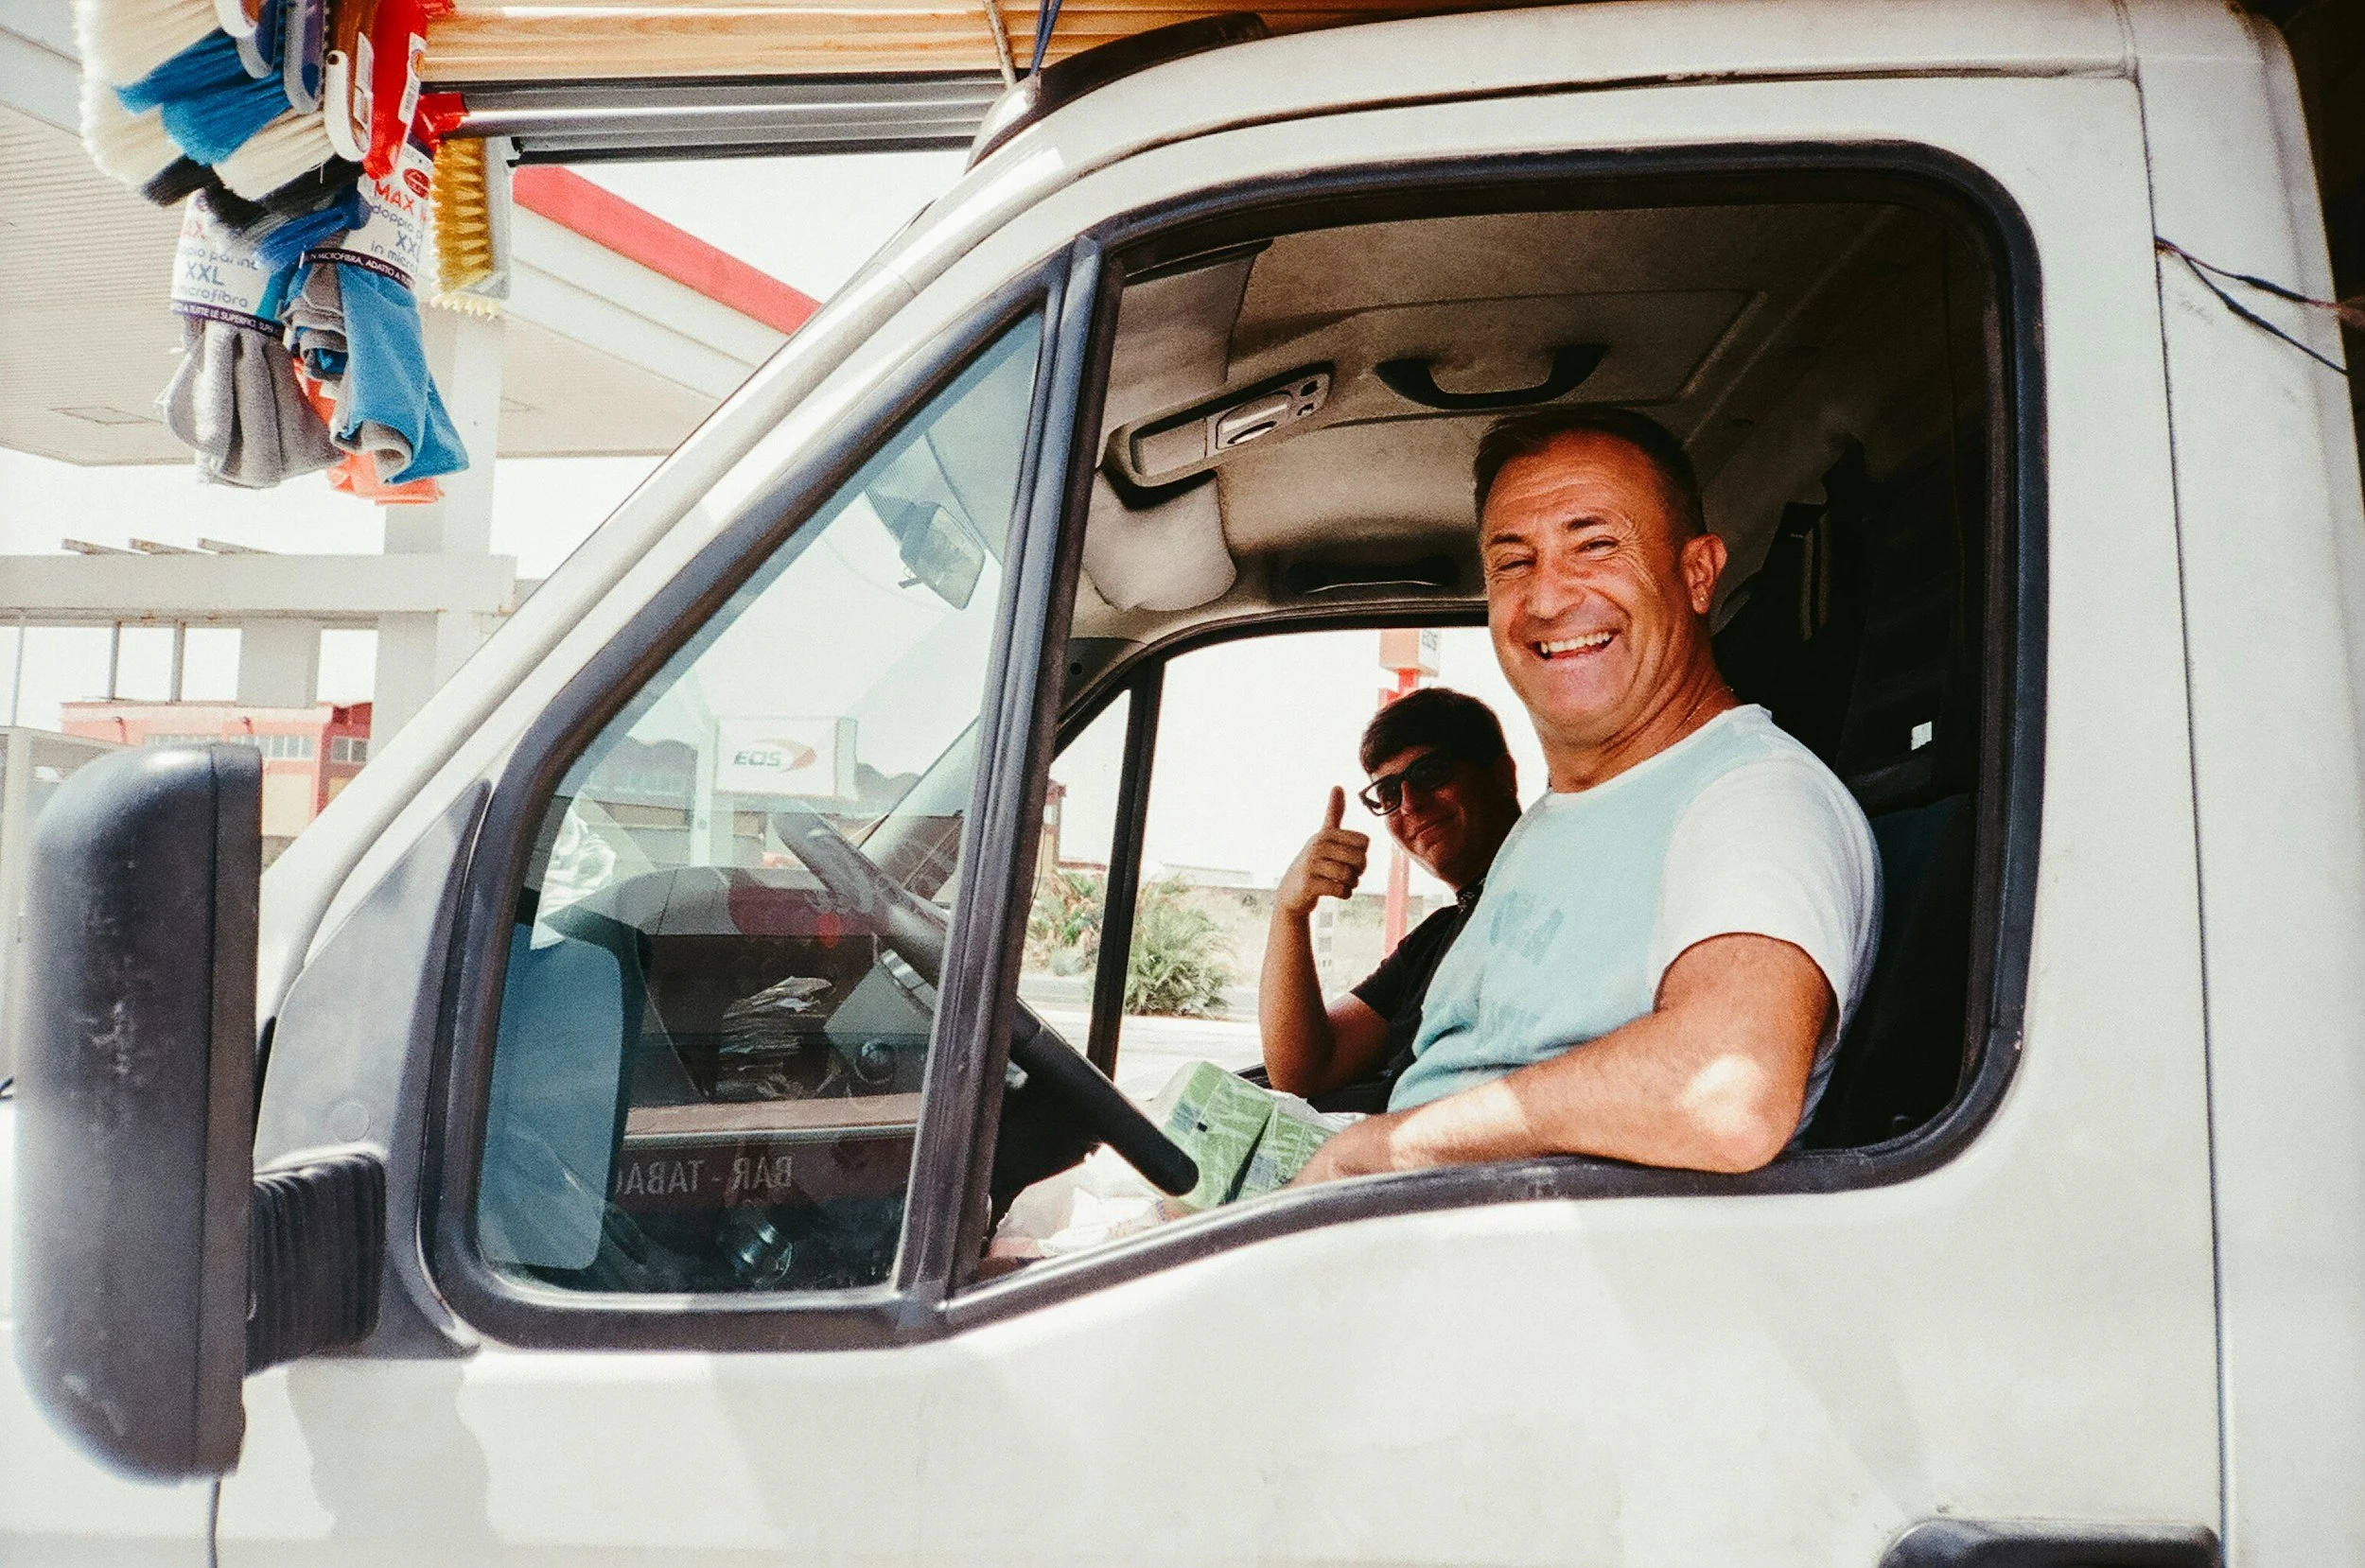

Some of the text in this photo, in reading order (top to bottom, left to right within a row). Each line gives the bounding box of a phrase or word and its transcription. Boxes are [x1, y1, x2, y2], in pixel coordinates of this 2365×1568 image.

[375, 180, 414, 216] MAX
[370, 240, 384, 256] in
[184, 260, 225, 287] XXL
[364, 259, 394, 277] ADATTO
[188, 305, 209, 318] TUTTE
[209, 307, 219, 320] LE
[733, 750, 782, 767] EOS
